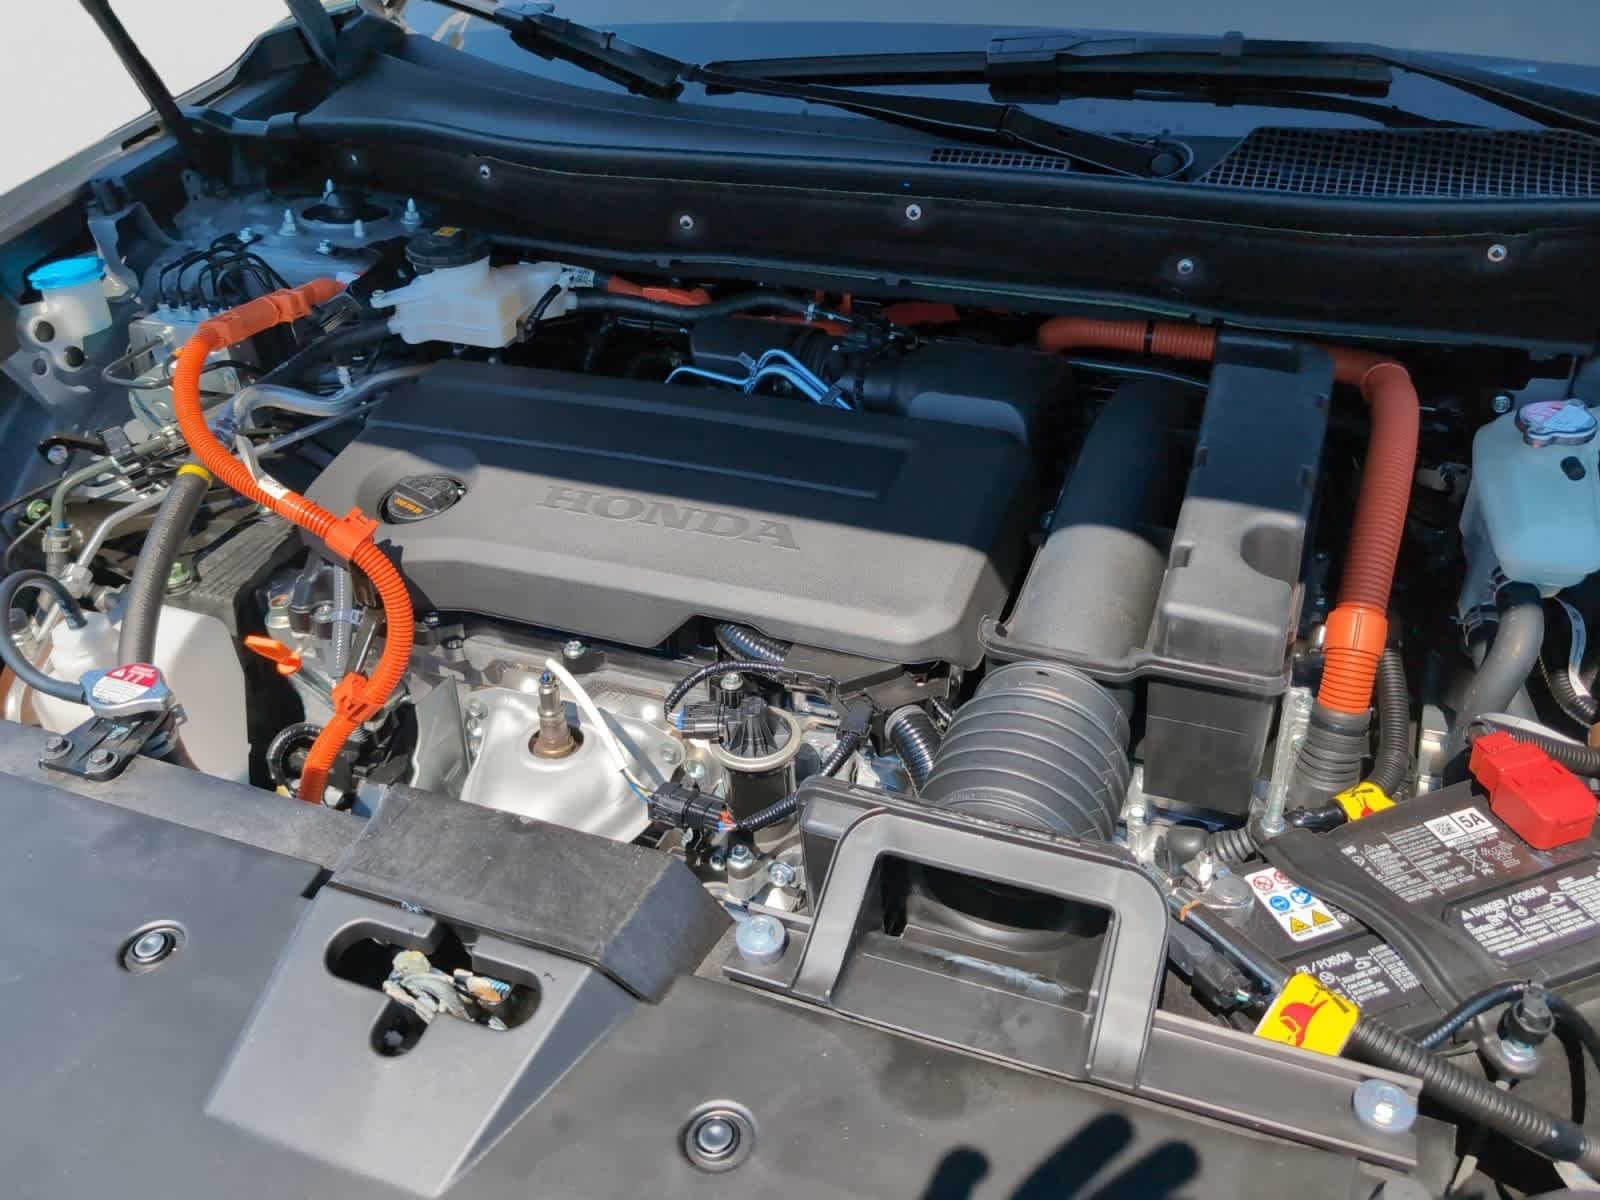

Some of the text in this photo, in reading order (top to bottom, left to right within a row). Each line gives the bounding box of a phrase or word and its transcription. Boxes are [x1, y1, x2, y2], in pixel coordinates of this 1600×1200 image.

[535, 485, 801, 551] HONDA
[1458, 812, 1486, 829] 5A
[1316, 951, 1354, 970] POISON
